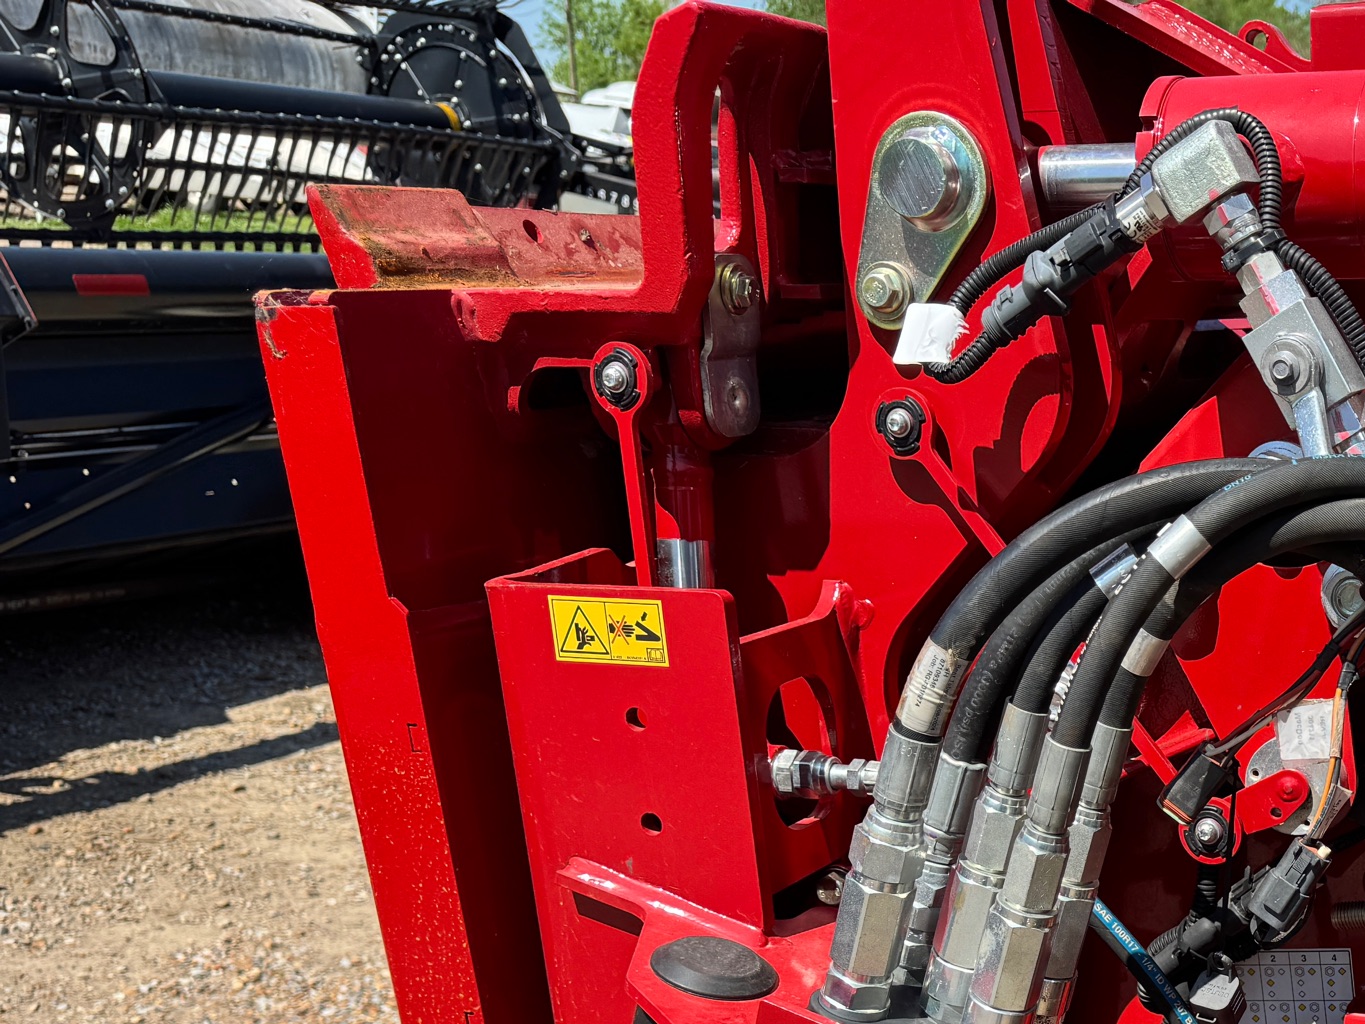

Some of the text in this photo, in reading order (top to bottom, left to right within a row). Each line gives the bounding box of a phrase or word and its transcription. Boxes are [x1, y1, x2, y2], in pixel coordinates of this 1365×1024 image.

[1094, 902, 1112, 923] SAE
[1110, 920, 1140, 953] 100R17
[1154, 975, 1165, 986] ID
[1163, 984, 1177, 1001] WP
[1173, 1000, 1188, 1018] 207
[1301, 954, 1307, 962] 3
[1331, 954, 1337, 962] 4
